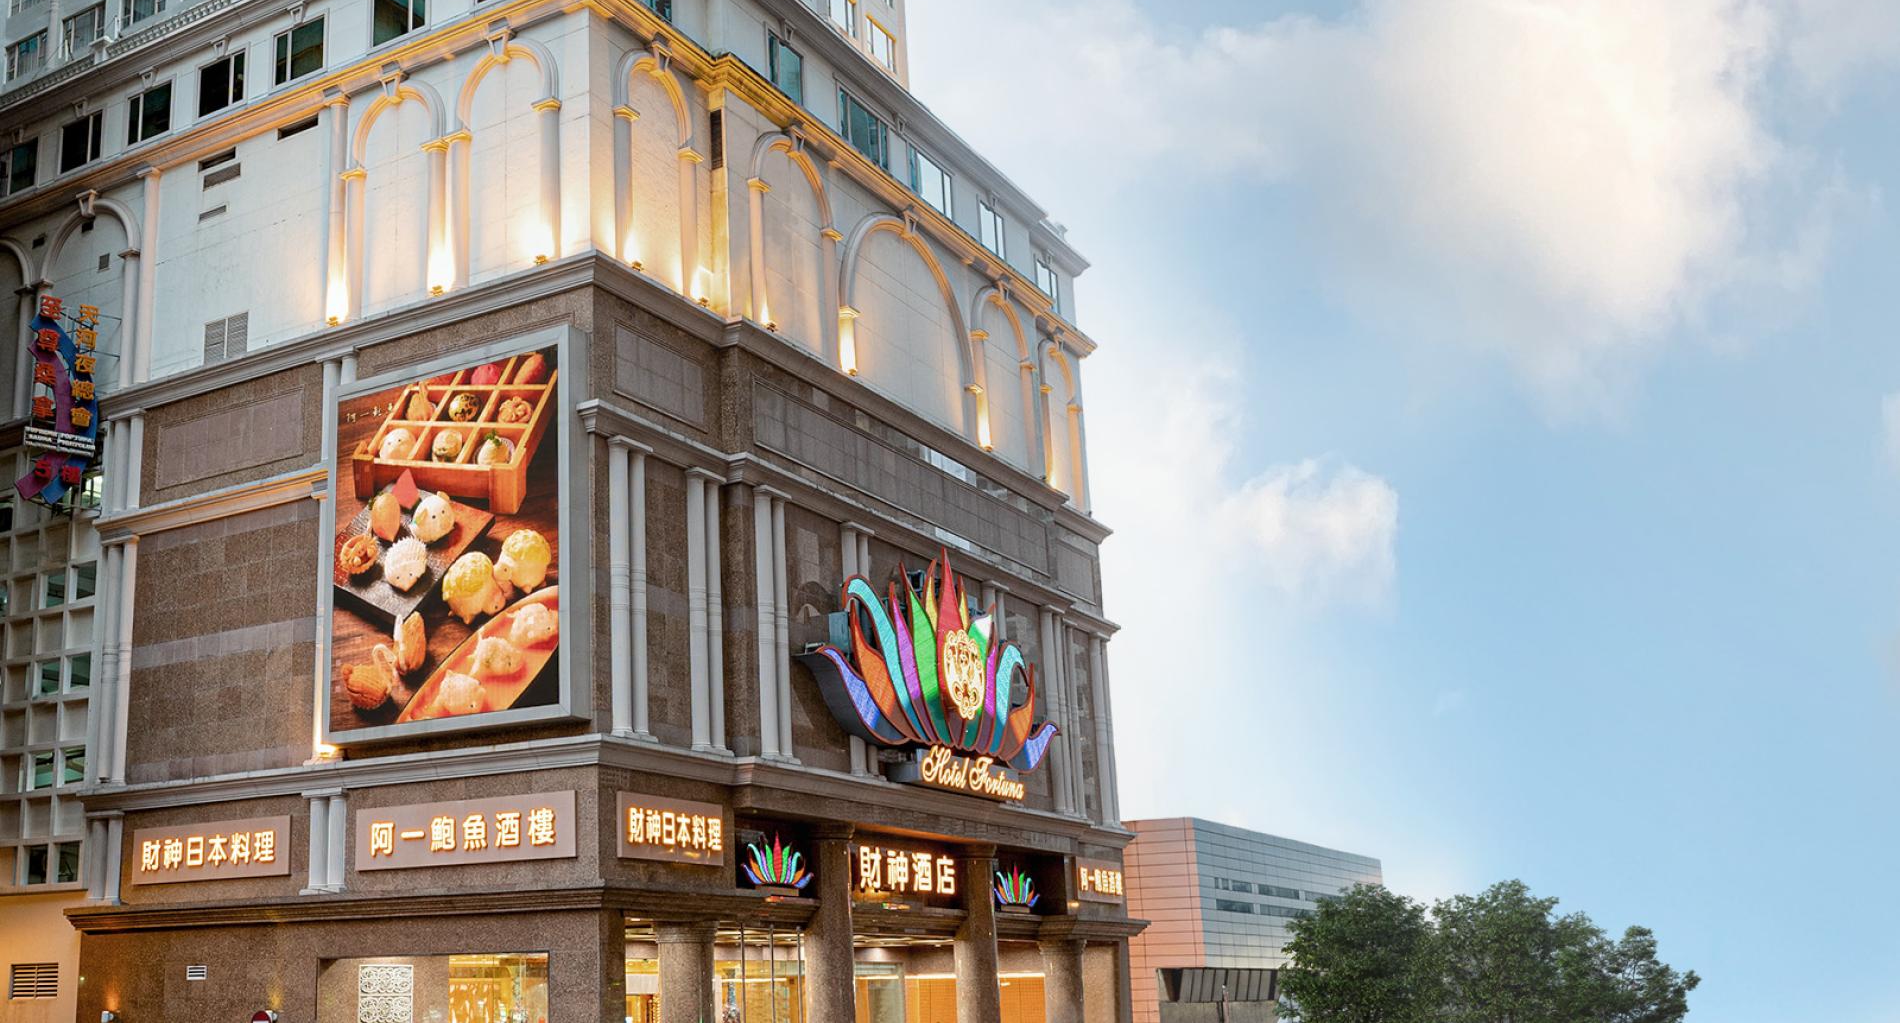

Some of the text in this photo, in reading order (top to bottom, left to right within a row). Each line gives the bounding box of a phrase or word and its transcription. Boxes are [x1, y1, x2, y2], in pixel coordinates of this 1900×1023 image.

[922, 745, 1024, 800] Hotel Fortuna
[140, 830, 276, 872] 財神日本料理
[370, 807, 556, 857] 阿一鮑魚酒樓
[628, 807, 722, 851] 財神日本料理
[859, 845, 956, 895] 財神酒店
